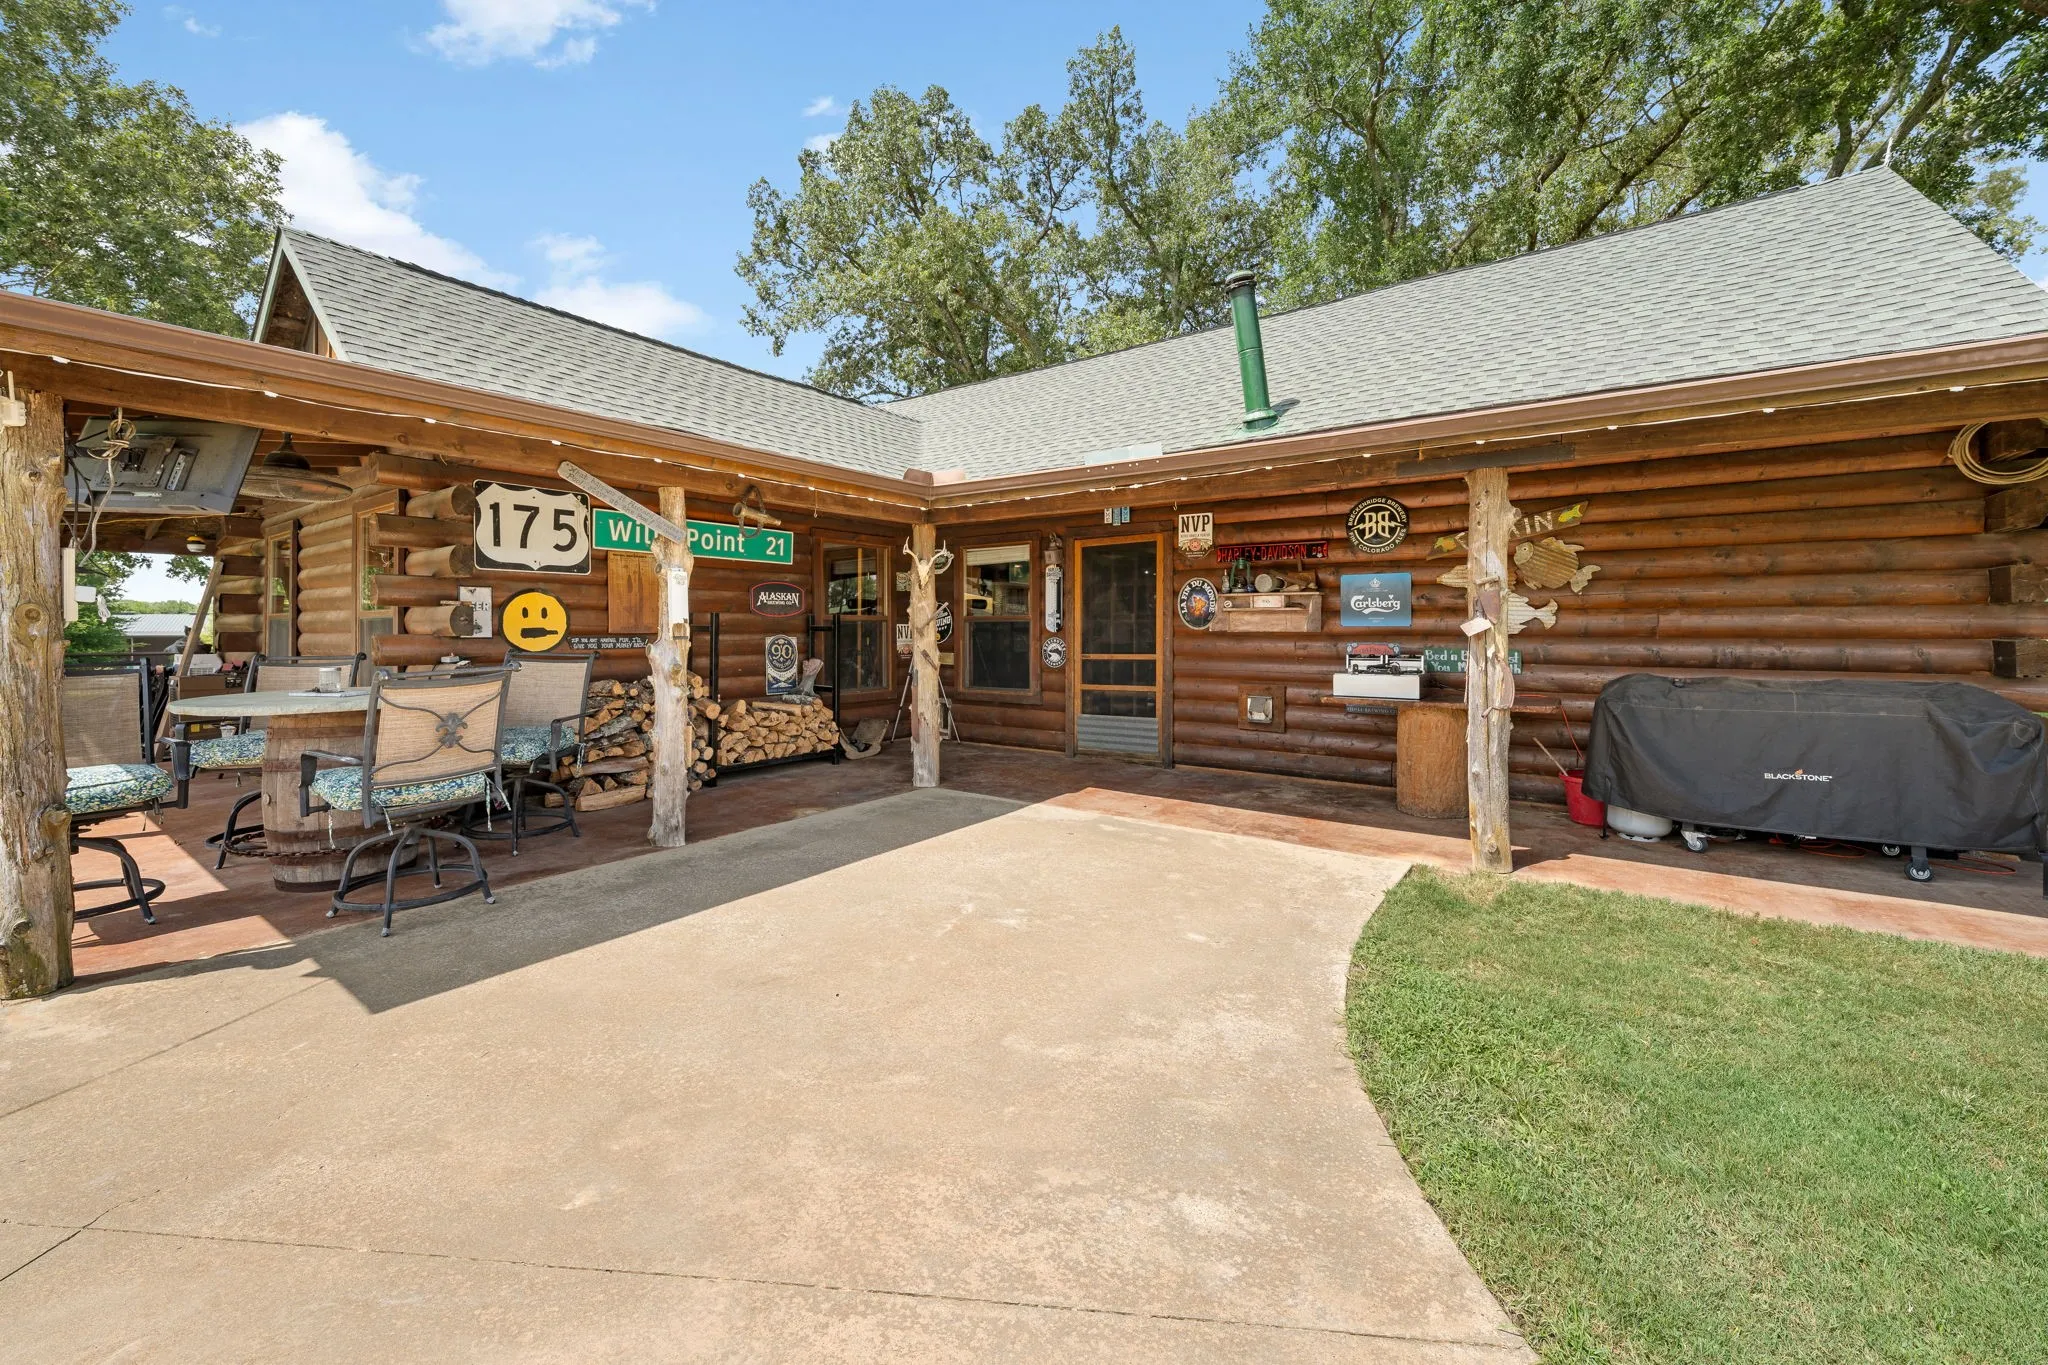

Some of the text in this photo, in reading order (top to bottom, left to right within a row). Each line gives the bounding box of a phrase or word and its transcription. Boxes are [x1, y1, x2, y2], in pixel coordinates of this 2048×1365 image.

[1347, 497, 1407, 526] BRECKENRIDGE BREWERY
[489, 501, 578, 552] 175
[1181, 514, 1210, 533] NVP
[608, 519, 659, 545] Wil
[687, 528, 745, 553] Point
[766, 537, 785, 556] 21
[1349, 528, 1407, 553] FINE COLORADO ALES
[1221, 543, 1307, 562] HARLEY-DAVIDSON
[756, 591, 800, 607] ALASKAN
[1180, 580, 1216, 614] LA FIN DU MONDE
[1350, 594, 1401, 614] Carlsberg
[897, 625, 912, 639] NV
[771, 644, 792, 659] 90
[1425, 649, 1447, 661] Bed
[1430, 661, 1451, 672] You
[1764, 772, 1830, 782] BLACKSTONE
